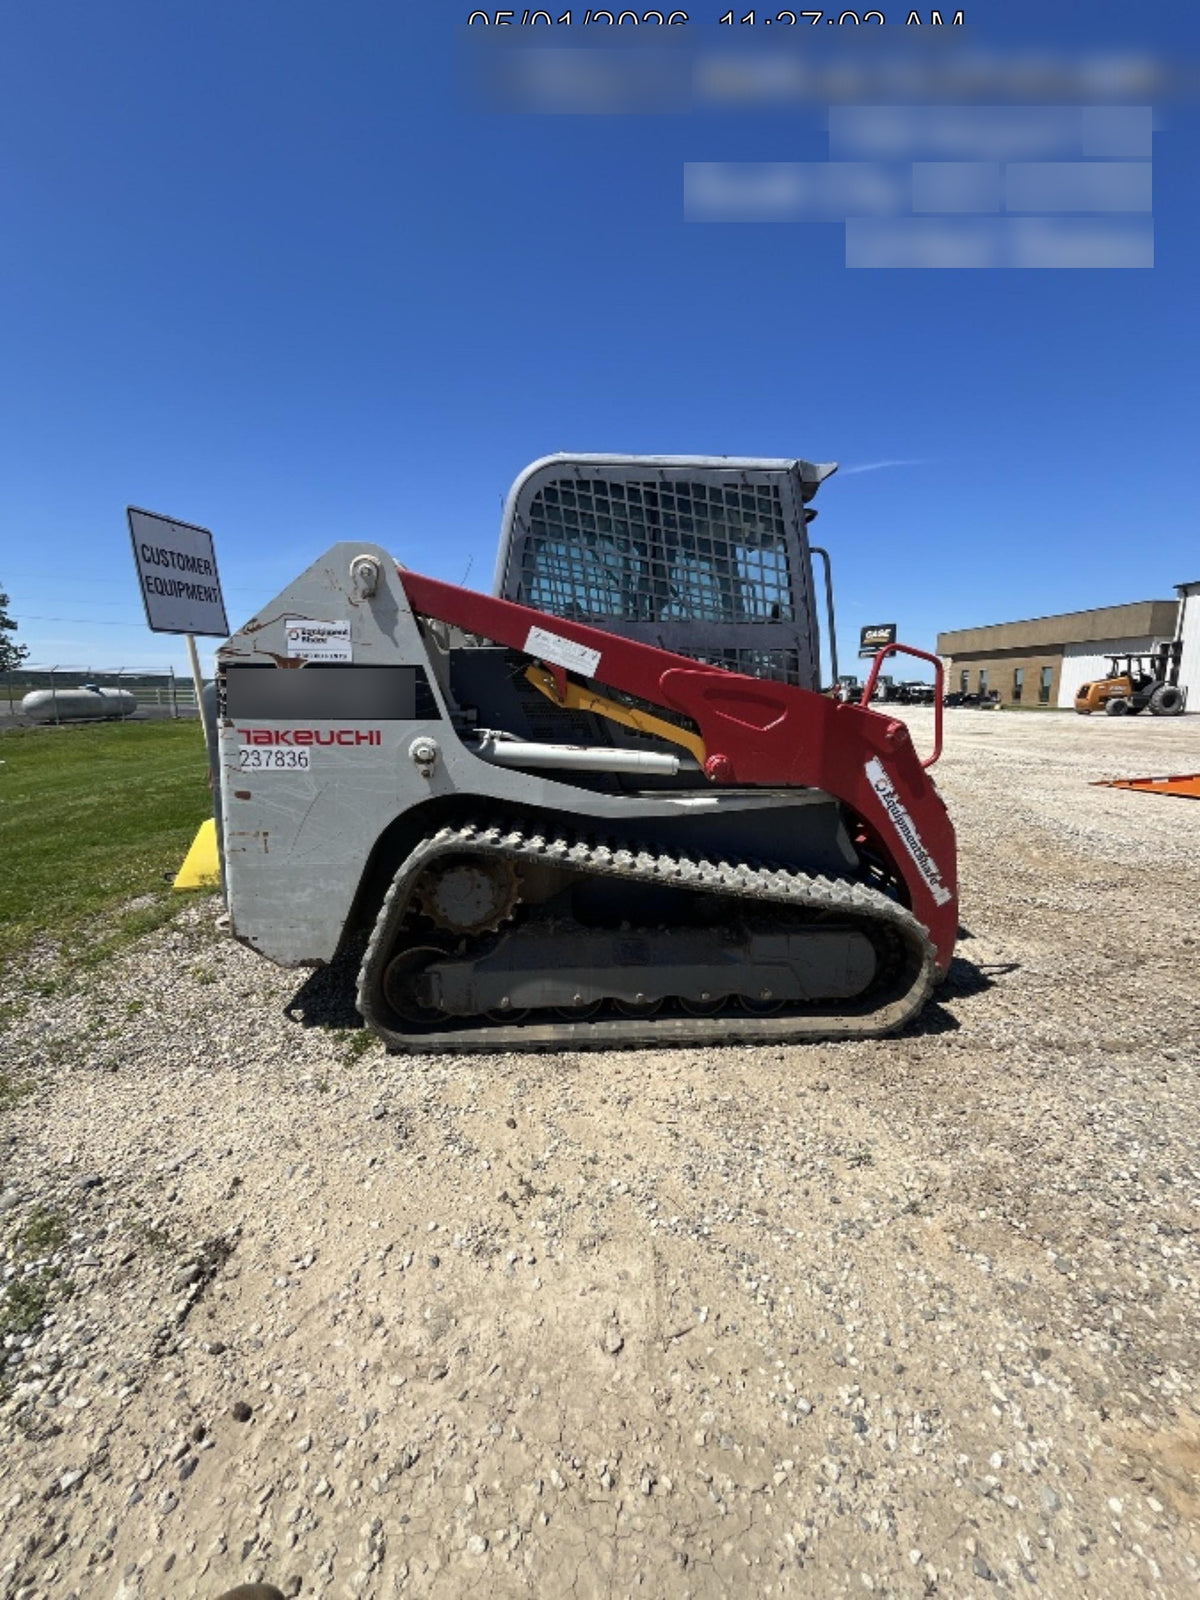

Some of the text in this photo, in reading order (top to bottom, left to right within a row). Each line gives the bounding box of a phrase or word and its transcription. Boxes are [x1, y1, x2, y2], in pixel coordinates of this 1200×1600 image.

[141, 543, 212, 576] CUSTOMER
[145, 575, 218, 603] EQUIPMENT
[865, 629, 892, 639] CASE
[239, 750, 309, 768] 237836
